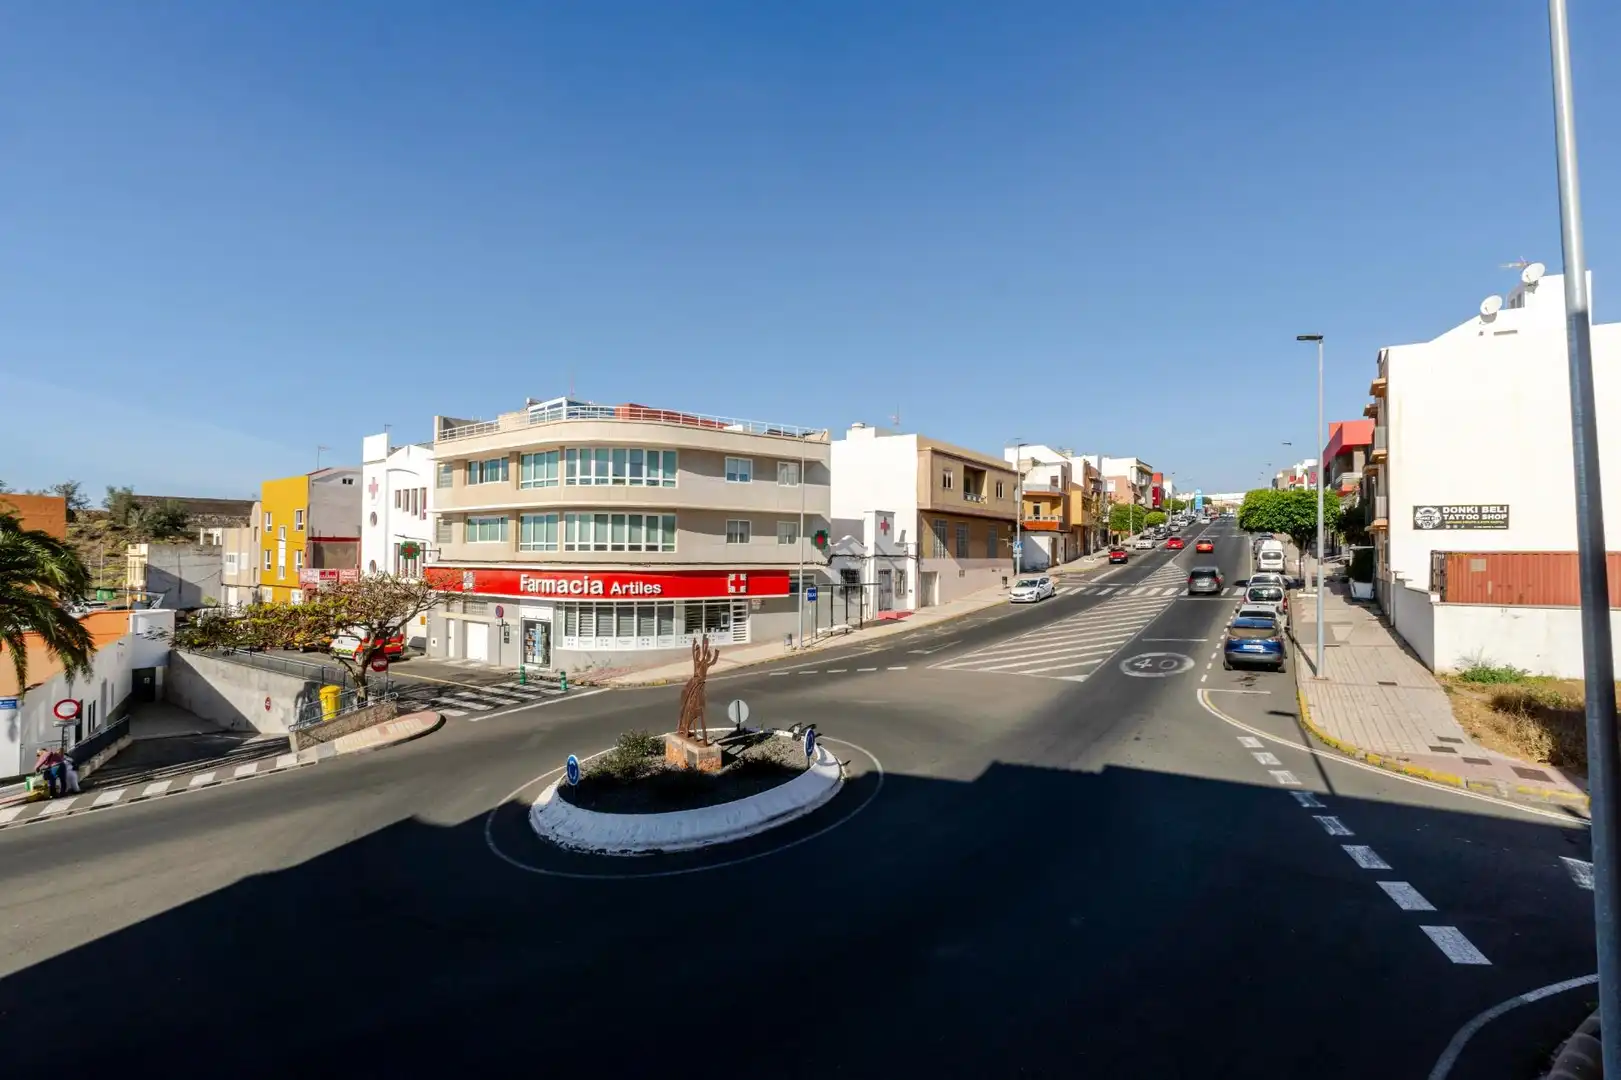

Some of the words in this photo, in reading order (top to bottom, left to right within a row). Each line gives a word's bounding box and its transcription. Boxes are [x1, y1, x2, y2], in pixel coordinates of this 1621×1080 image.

[1442, 506, 1478, 514] DONKI
[520, 574, 604, 594] Farmacia
[610, 581, 662, 594] Artiles
[1134, 658, 1178, 670] 40
